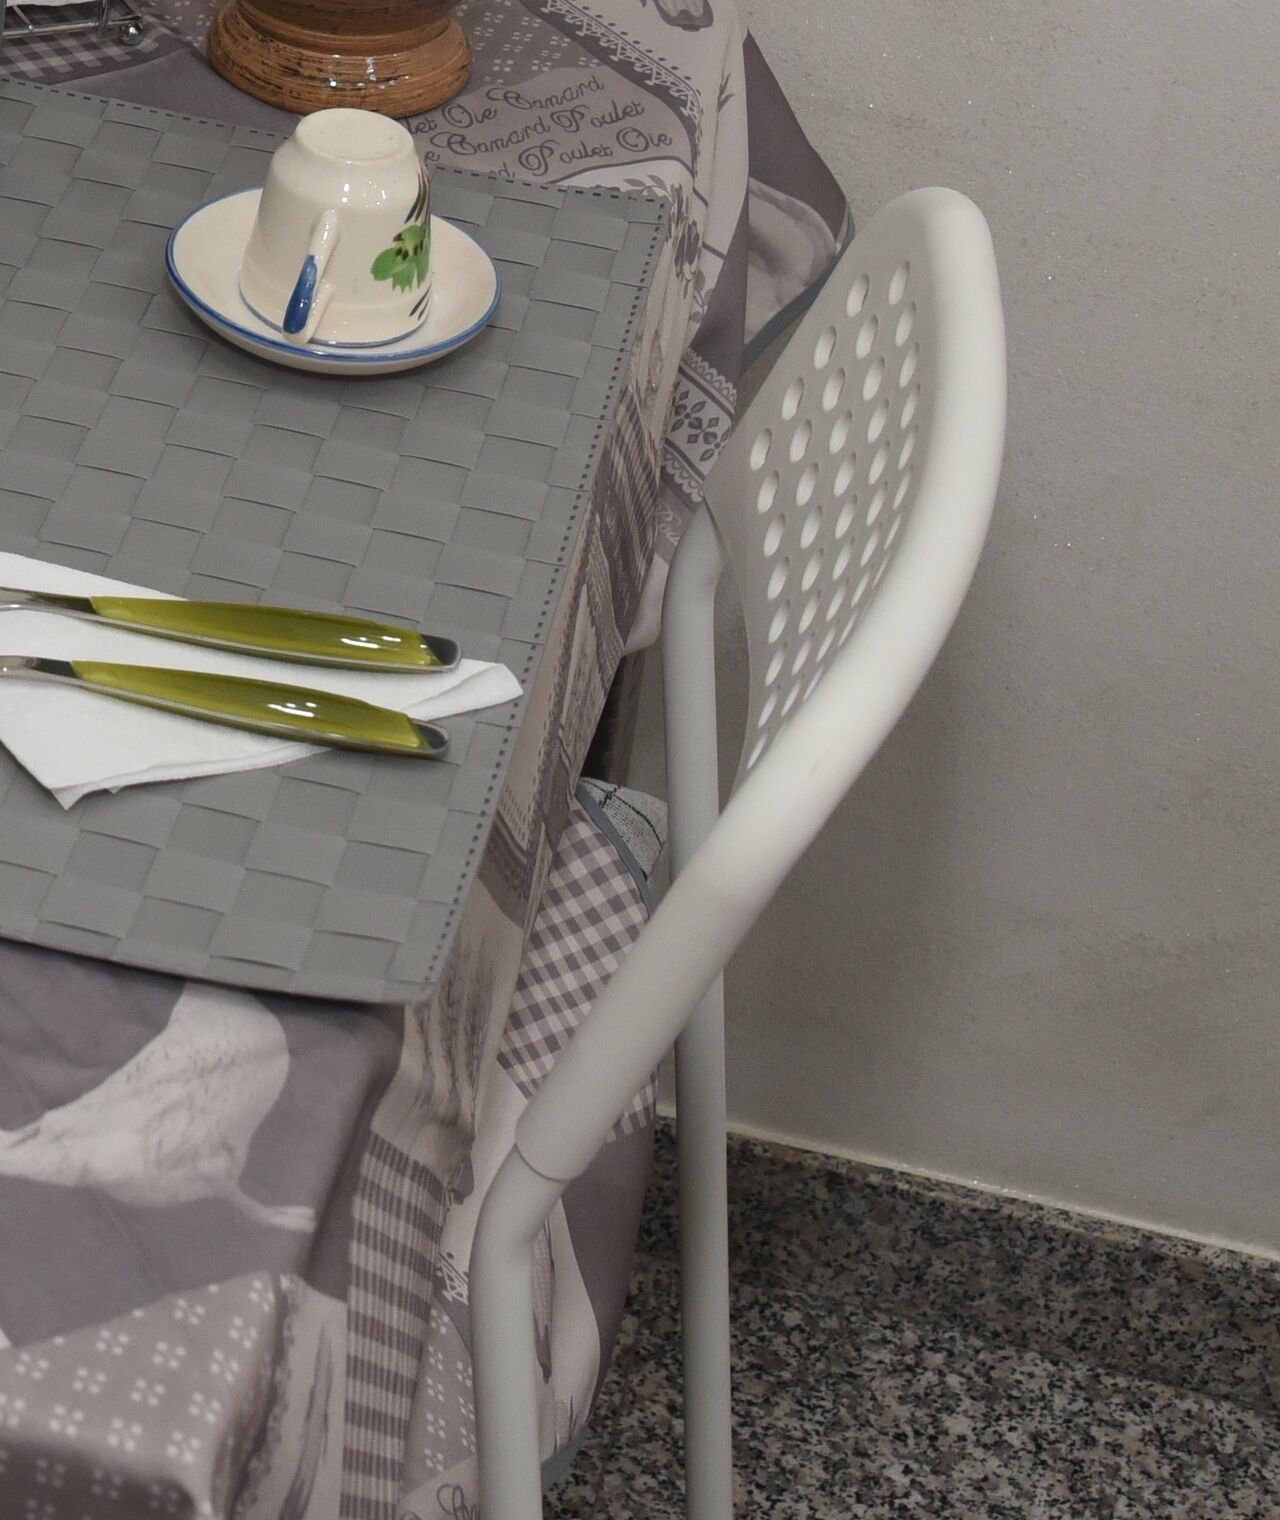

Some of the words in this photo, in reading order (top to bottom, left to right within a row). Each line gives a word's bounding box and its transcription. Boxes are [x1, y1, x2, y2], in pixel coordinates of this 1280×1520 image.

[442, 102, 498, 129] Oie
[550, 99, 645, 133] Poulet
[518, 139, 613, 177] Poulet
[616, 126, 673, 153] Oie
